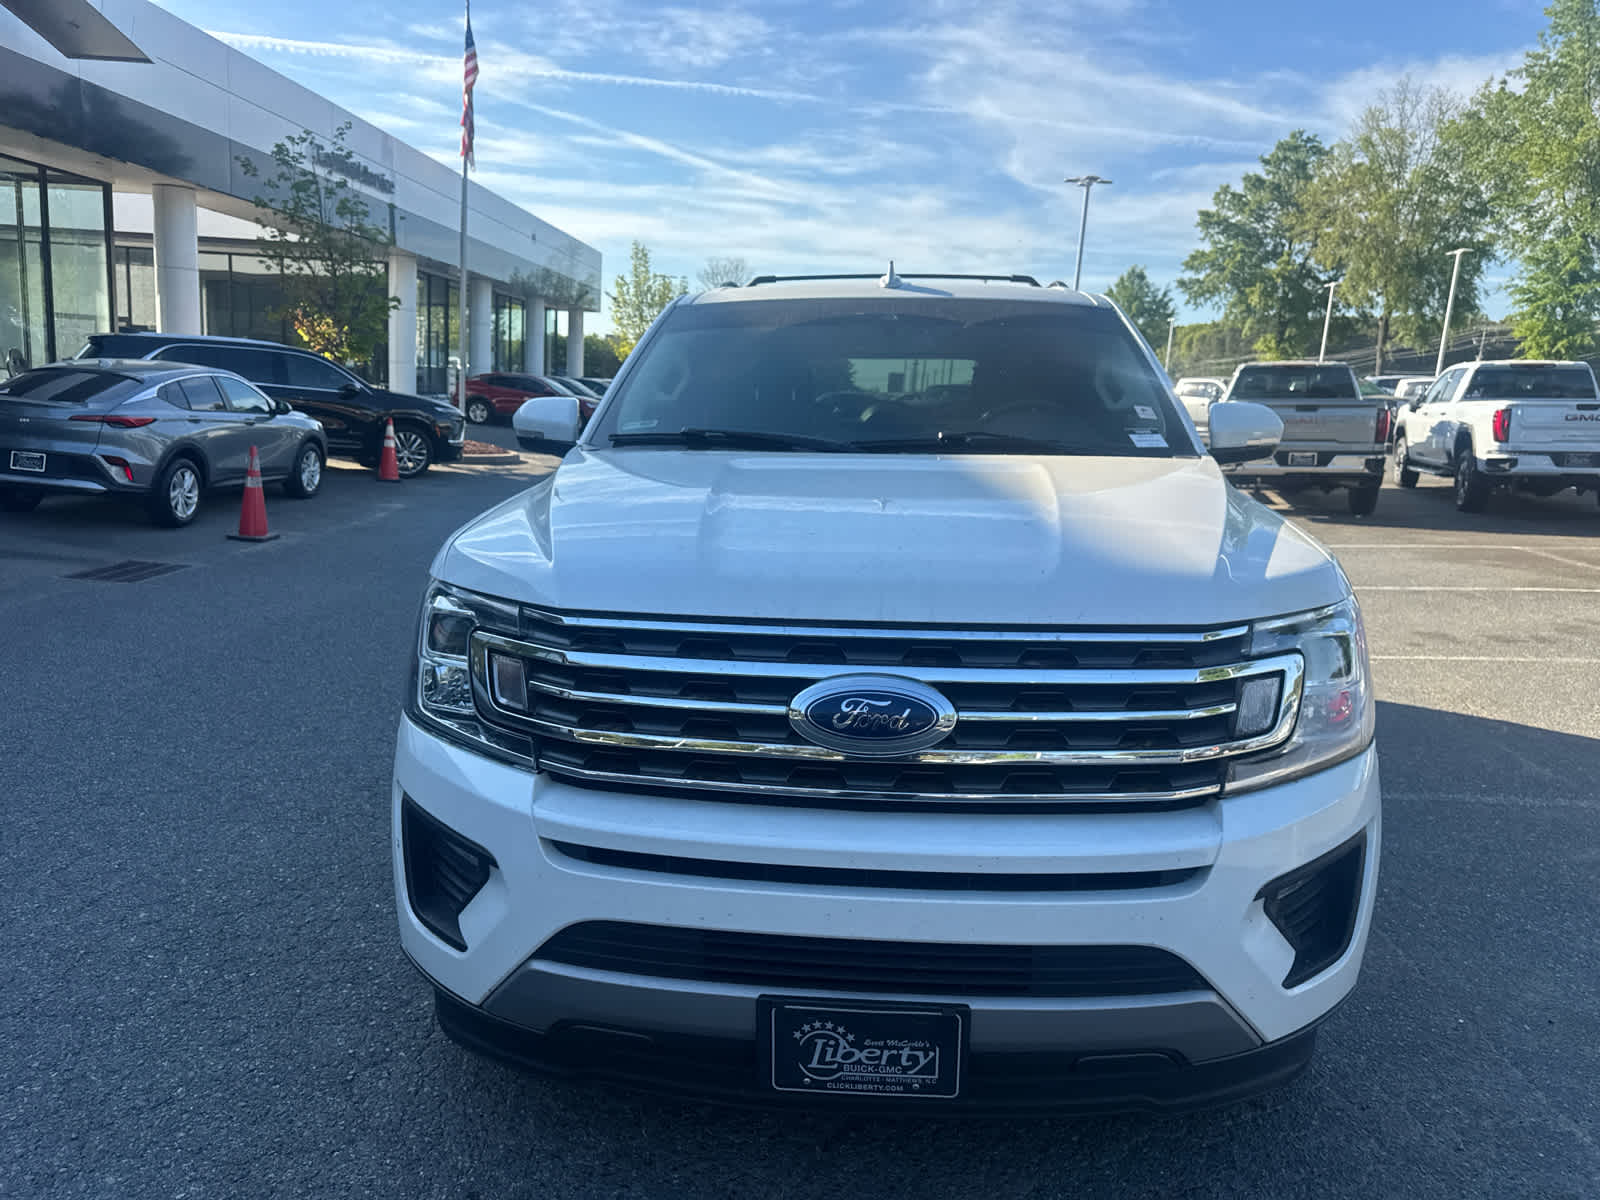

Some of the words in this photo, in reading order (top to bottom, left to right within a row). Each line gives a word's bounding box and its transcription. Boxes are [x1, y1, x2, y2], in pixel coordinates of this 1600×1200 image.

[833, 697, 912, 729] Ford
[808, 1039, 935, 1074] Liberty
[827, 1082, 904, 1092] CLICKLIBERTY.COM
